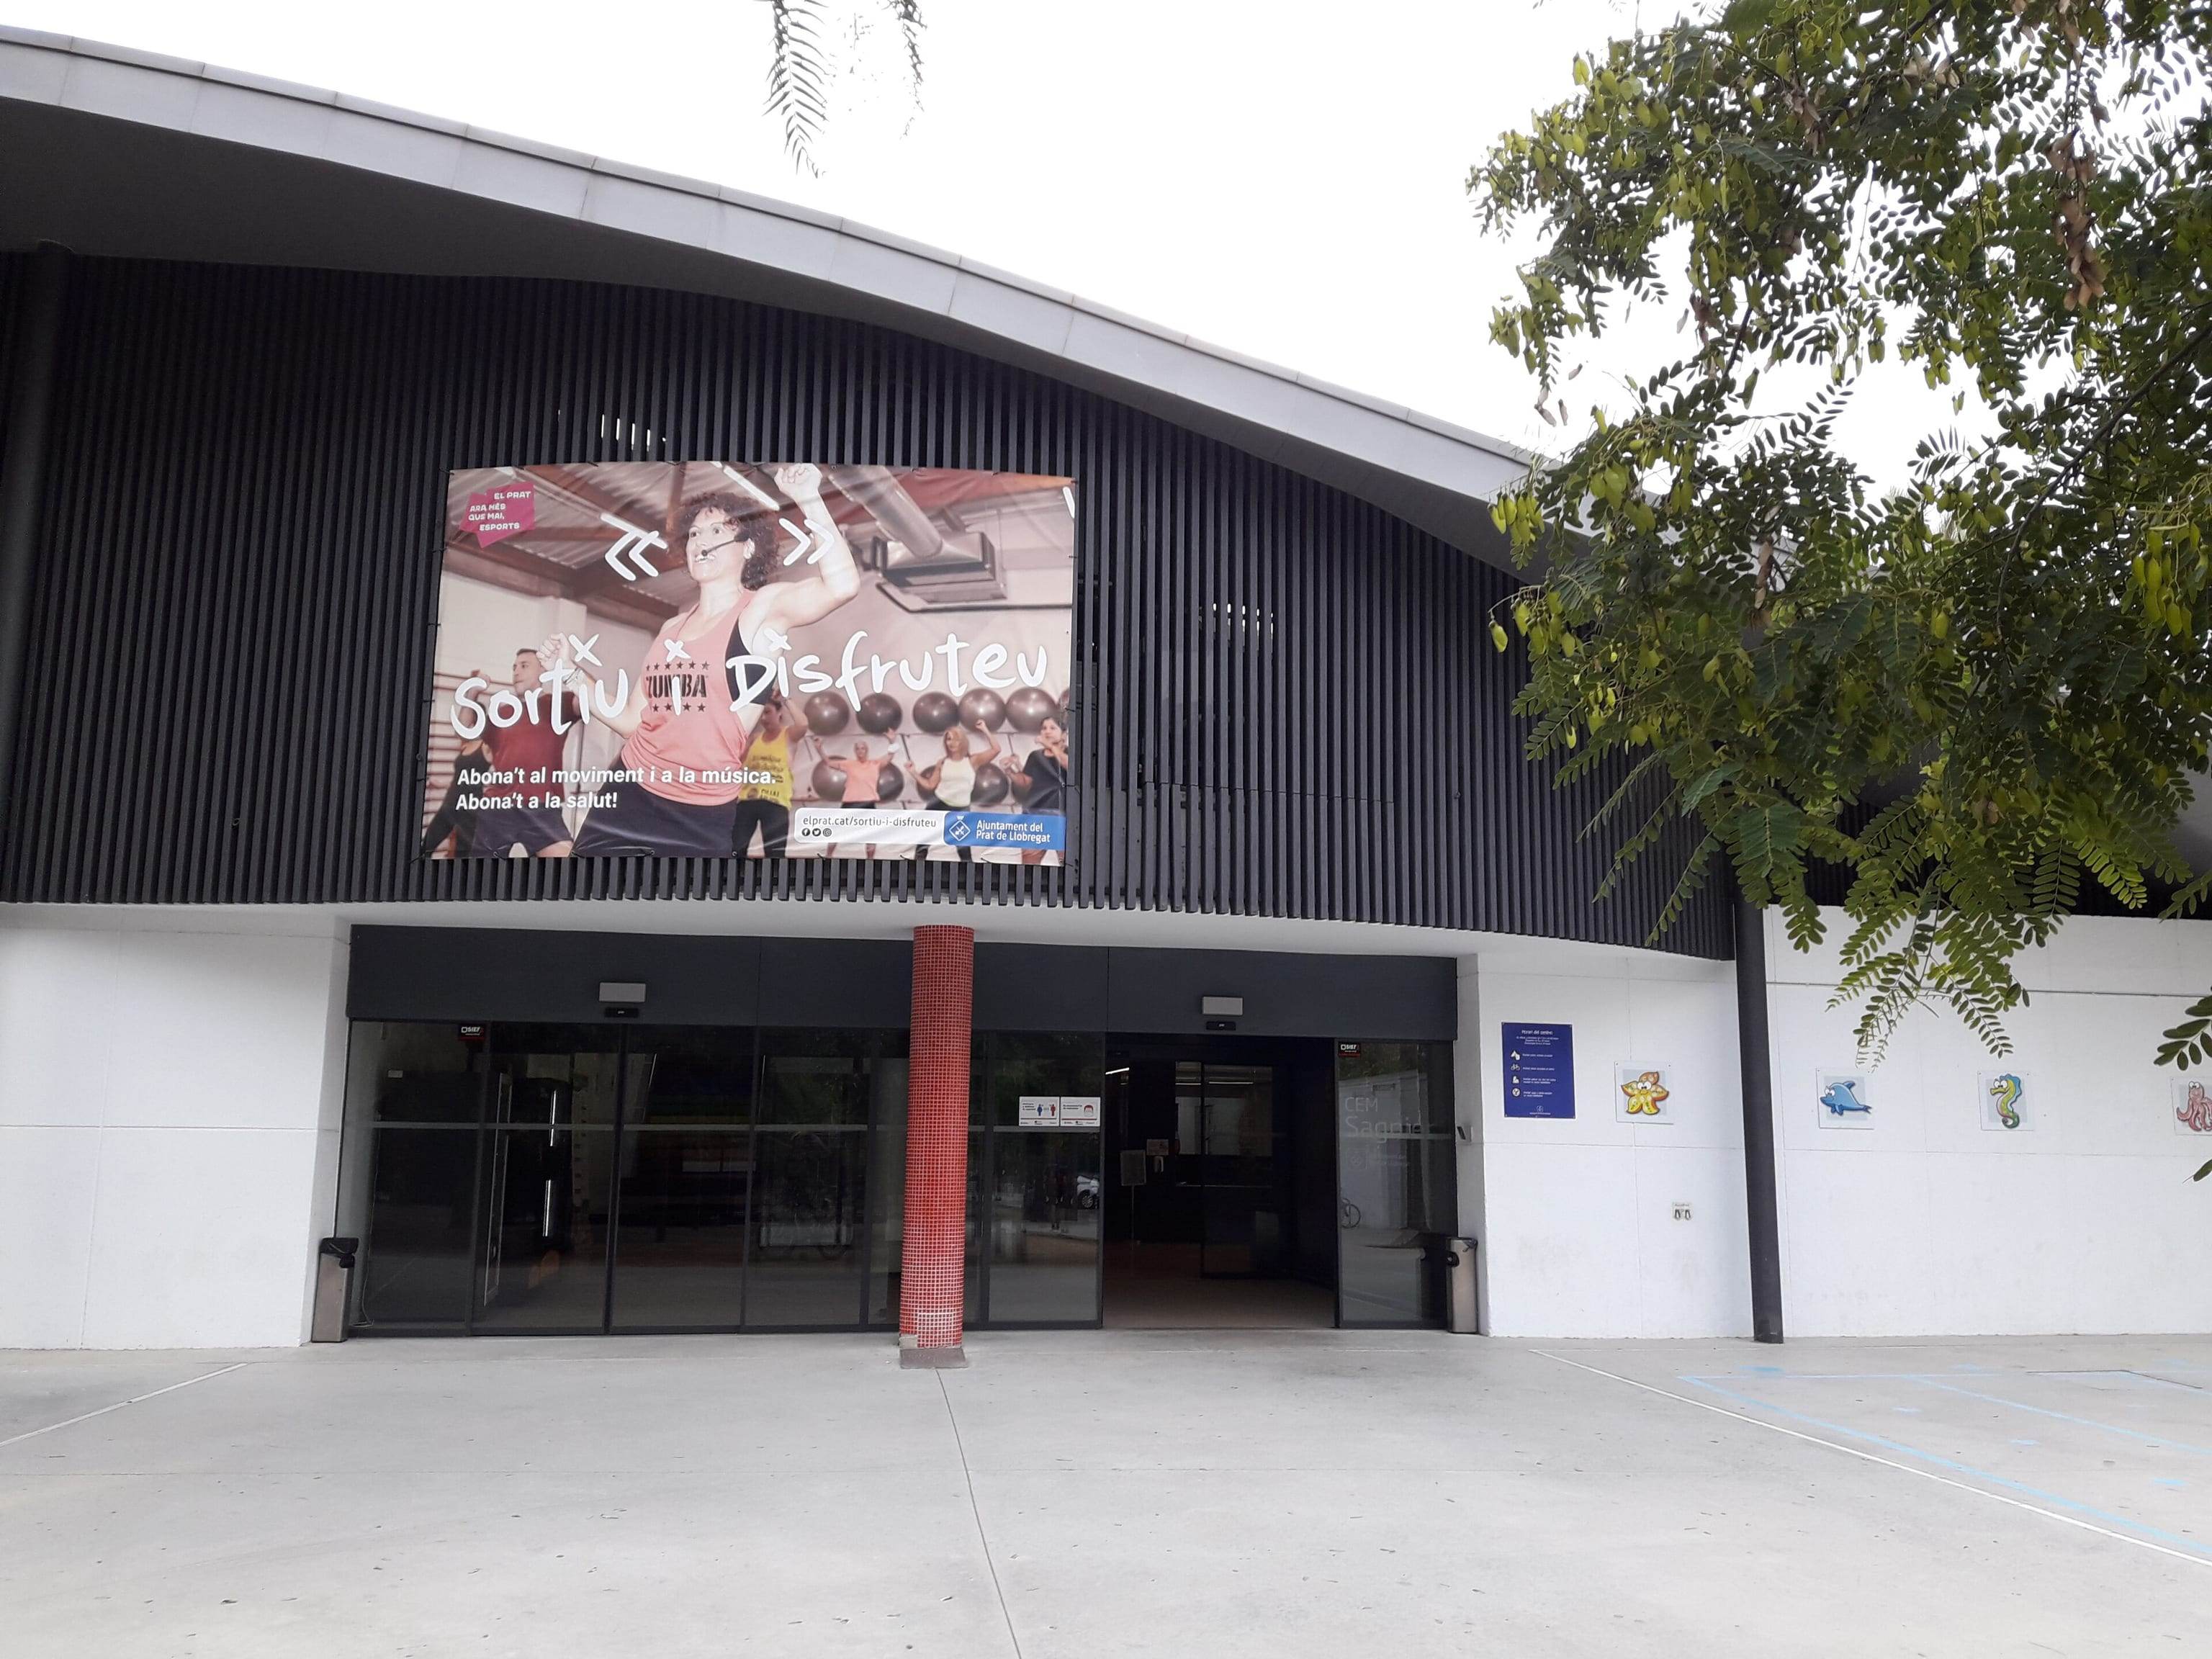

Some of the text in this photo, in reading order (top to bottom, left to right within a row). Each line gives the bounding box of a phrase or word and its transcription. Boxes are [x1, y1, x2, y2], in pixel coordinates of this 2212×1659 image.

[450, 634, 629, 740] Sortiu
[725, 629, 1048, 712] Disfruteu
[457, 767, 524, 786] Abona't
[530, 767, 546, 783] al
[552, 766, 644, 783] moviment
[649, 766, 656, 782] i
[661, 769, 672, 783] a
[679, 766, 695, 783] la
[702, 765, 776, 784] música.
[455, 791, 618, 810] Abona't a la salut!
[803, 816, 936, 827] elprat.cat/sortiu-i-disfruteu
[976, 820, 1043, 832] Ajuntament del
[976, 831, 1051, 843] Prat de Llobregat
[1345, 1097, 1378, 1112] CEM
